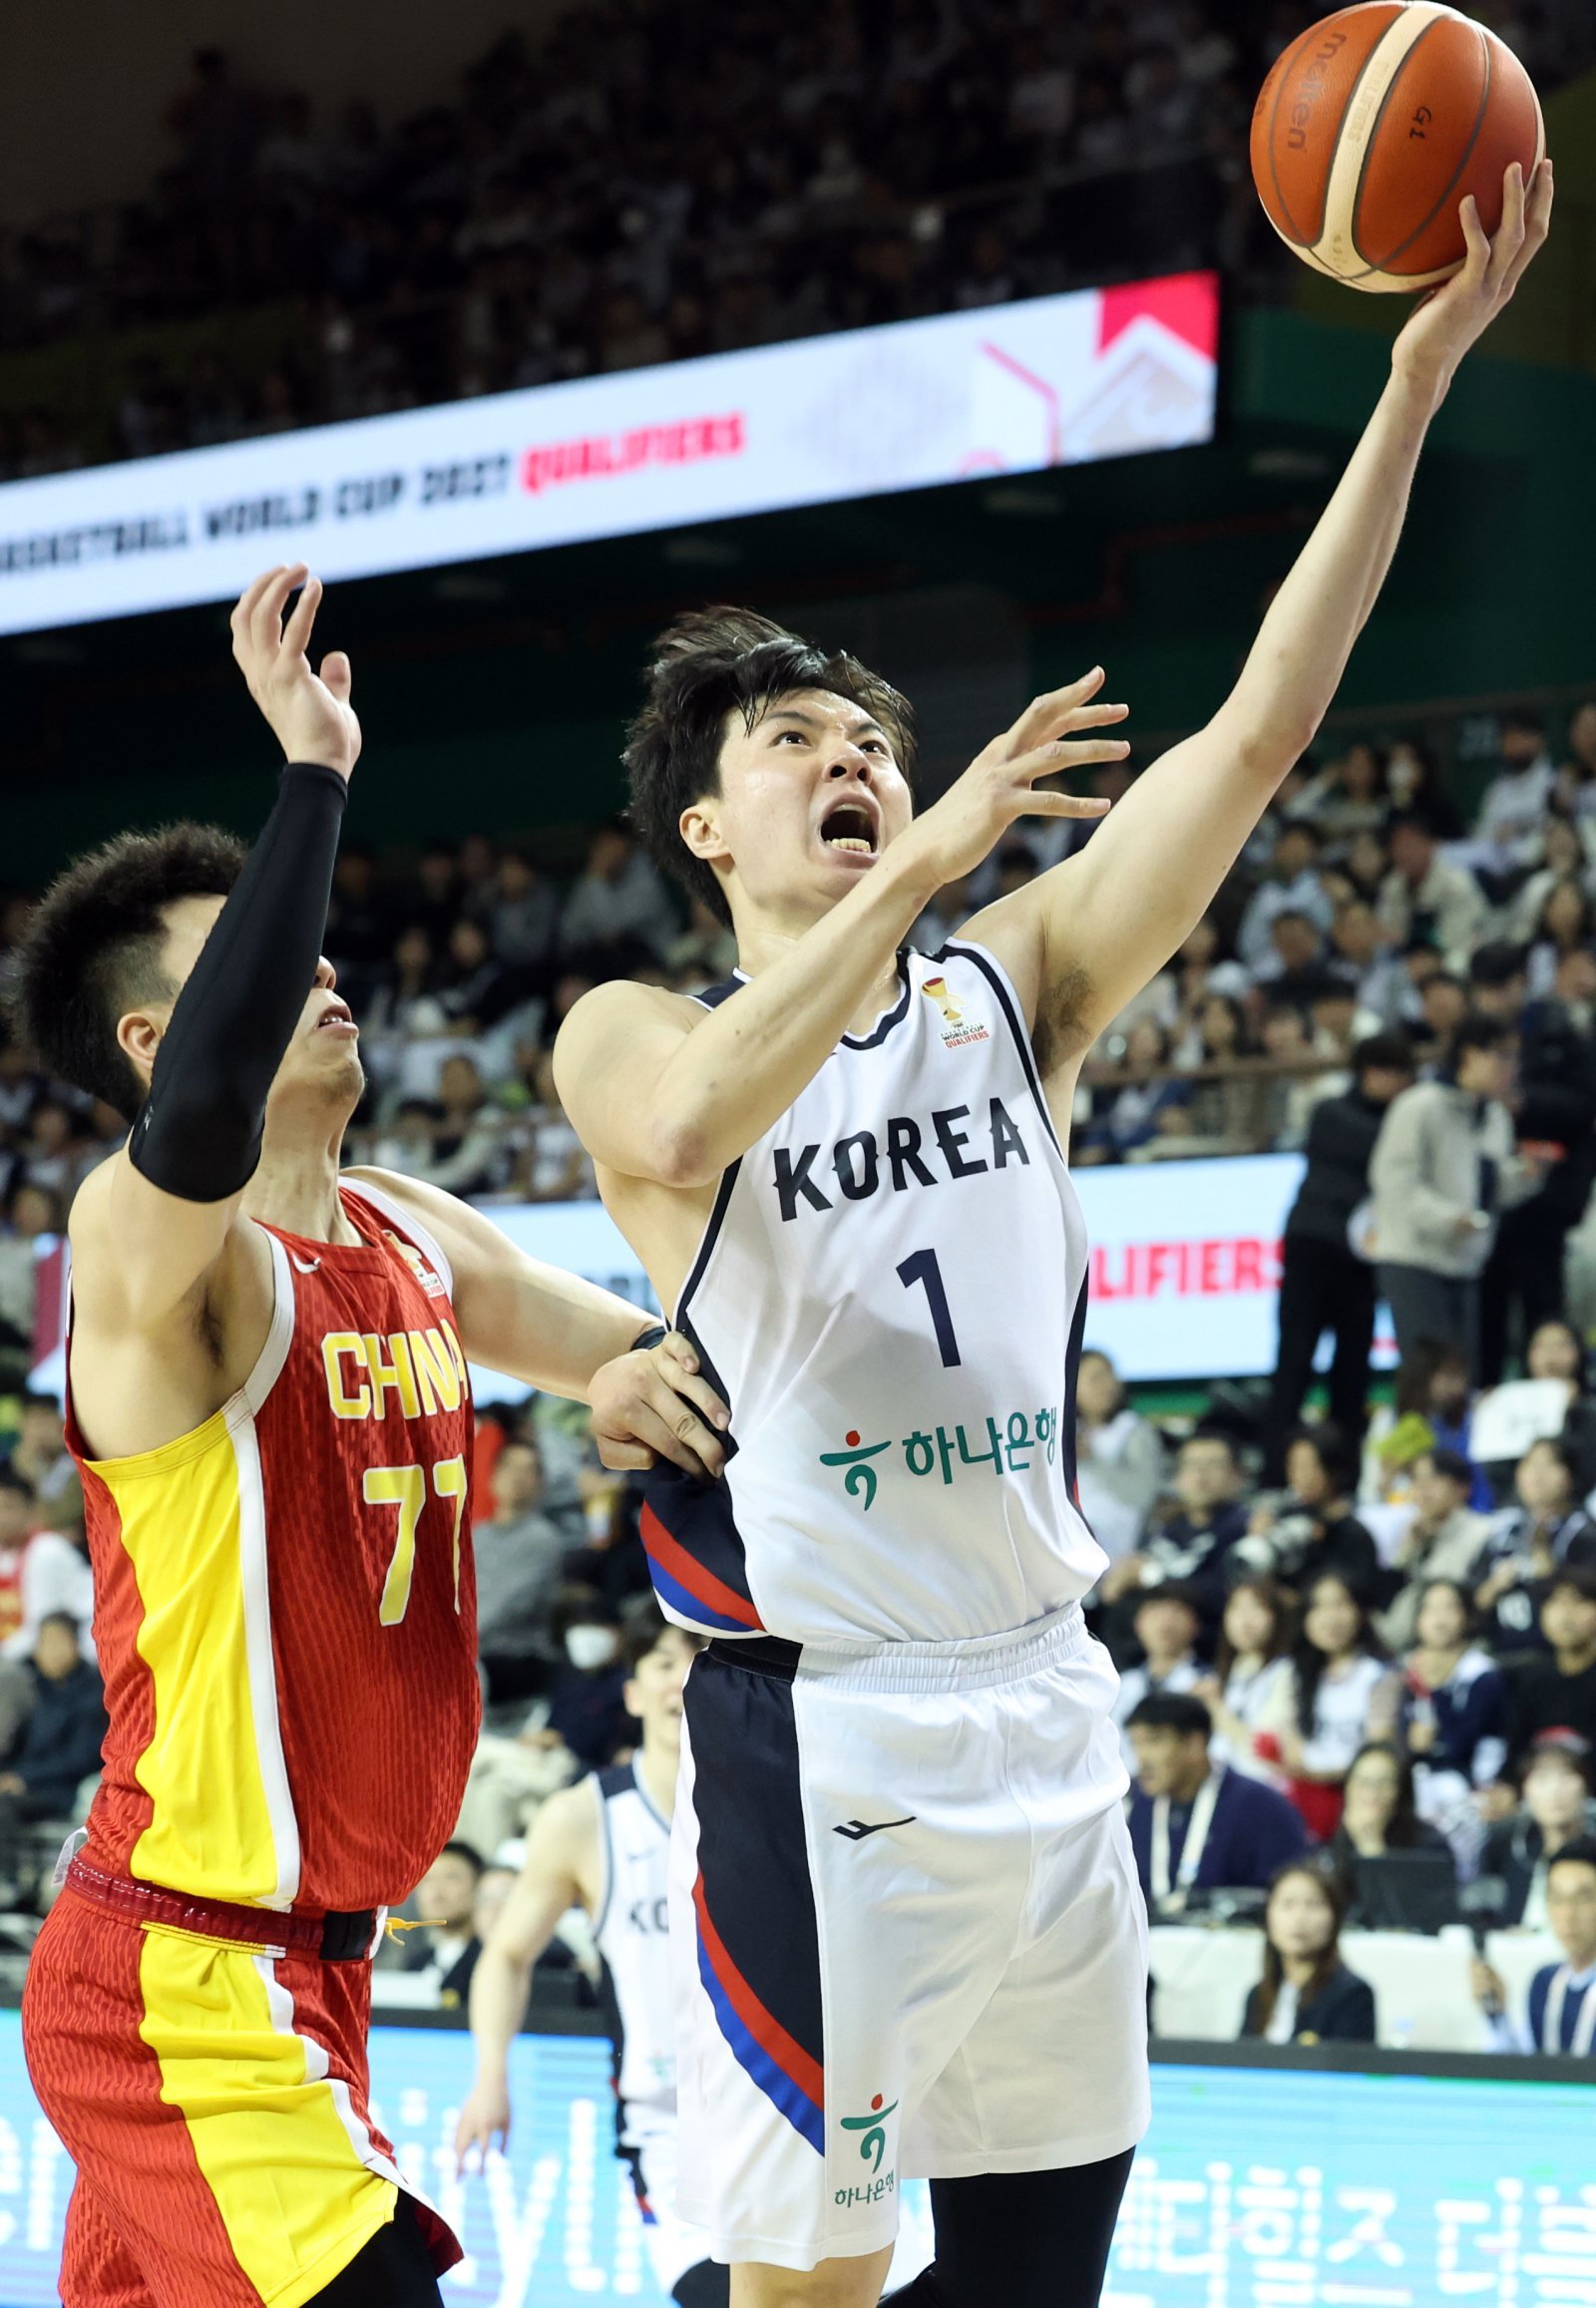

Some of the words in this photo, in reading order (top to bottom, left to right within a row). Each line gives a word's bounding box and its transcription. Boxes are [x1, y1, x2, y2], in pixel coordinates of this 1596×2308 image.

[1288, 32, 1347, 150] molten
[1409, 106, 1432, 140] G1
[204, 487, 319, 540] WORLD
[334, 473, 404, 518] CUP
[524, 412, 743, 494] QUALIFIERS
[942, 1029, 969, 1041] WORLD
[970, 1024, 985, 1033] CUP
[945, 1030, 990, 1048] QUALIFIERS
[773, 1097, 1029, 1222] KOREA
[895, 1248, 962, 1367] 1
[321, 1319, 469, 1421] CHINA
[902, 1406, 1057, 1485] 하나은행
[363, 1453, 468, 1626] 77
